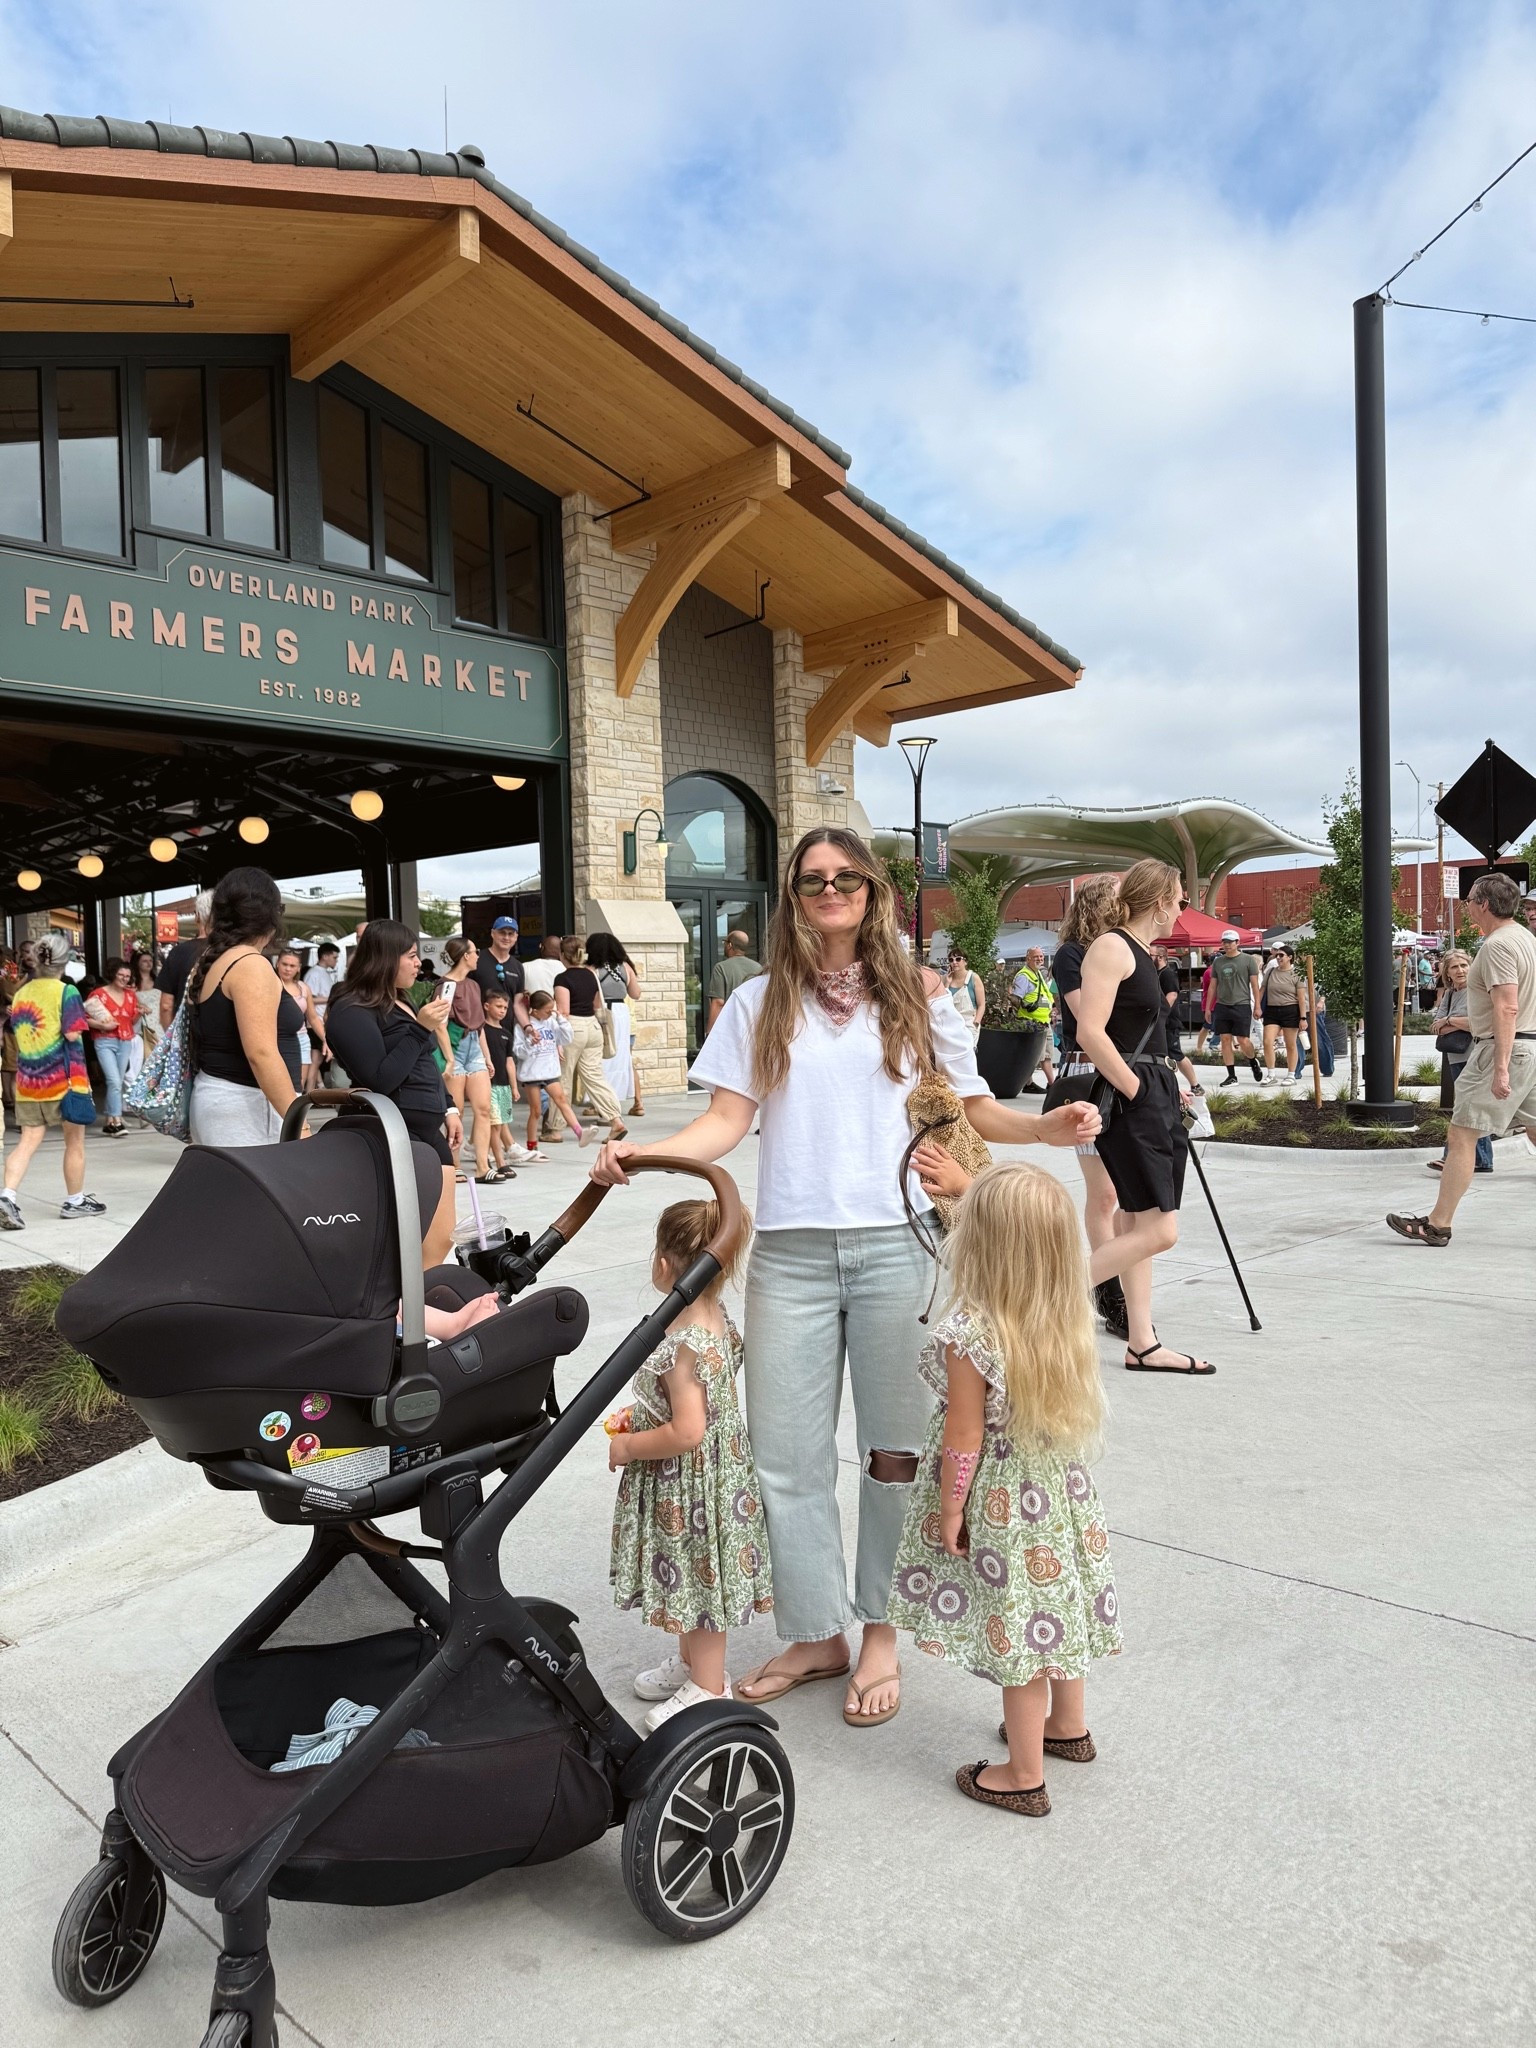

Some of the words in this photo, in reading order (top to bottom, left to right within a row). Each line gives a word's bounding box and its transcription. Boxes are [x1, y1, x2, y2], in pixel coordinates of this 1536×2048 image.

[189, 565, 337, 612] OVERLAND
[351, 596, 415, 626] PARK
[25, 587, 299, 666] FARMERS
[347, 641, 532, 701] MARKET
[260, 679, 304, 700] EST.
[314, 687, 361, 707] 1982
[302, 1213, 361, 1227] nuna
[312, 1487, 337, 1498] WARNING
[446, 1475, 477, 1491] nuna
[524, 1636, 560, 1674] nuna
